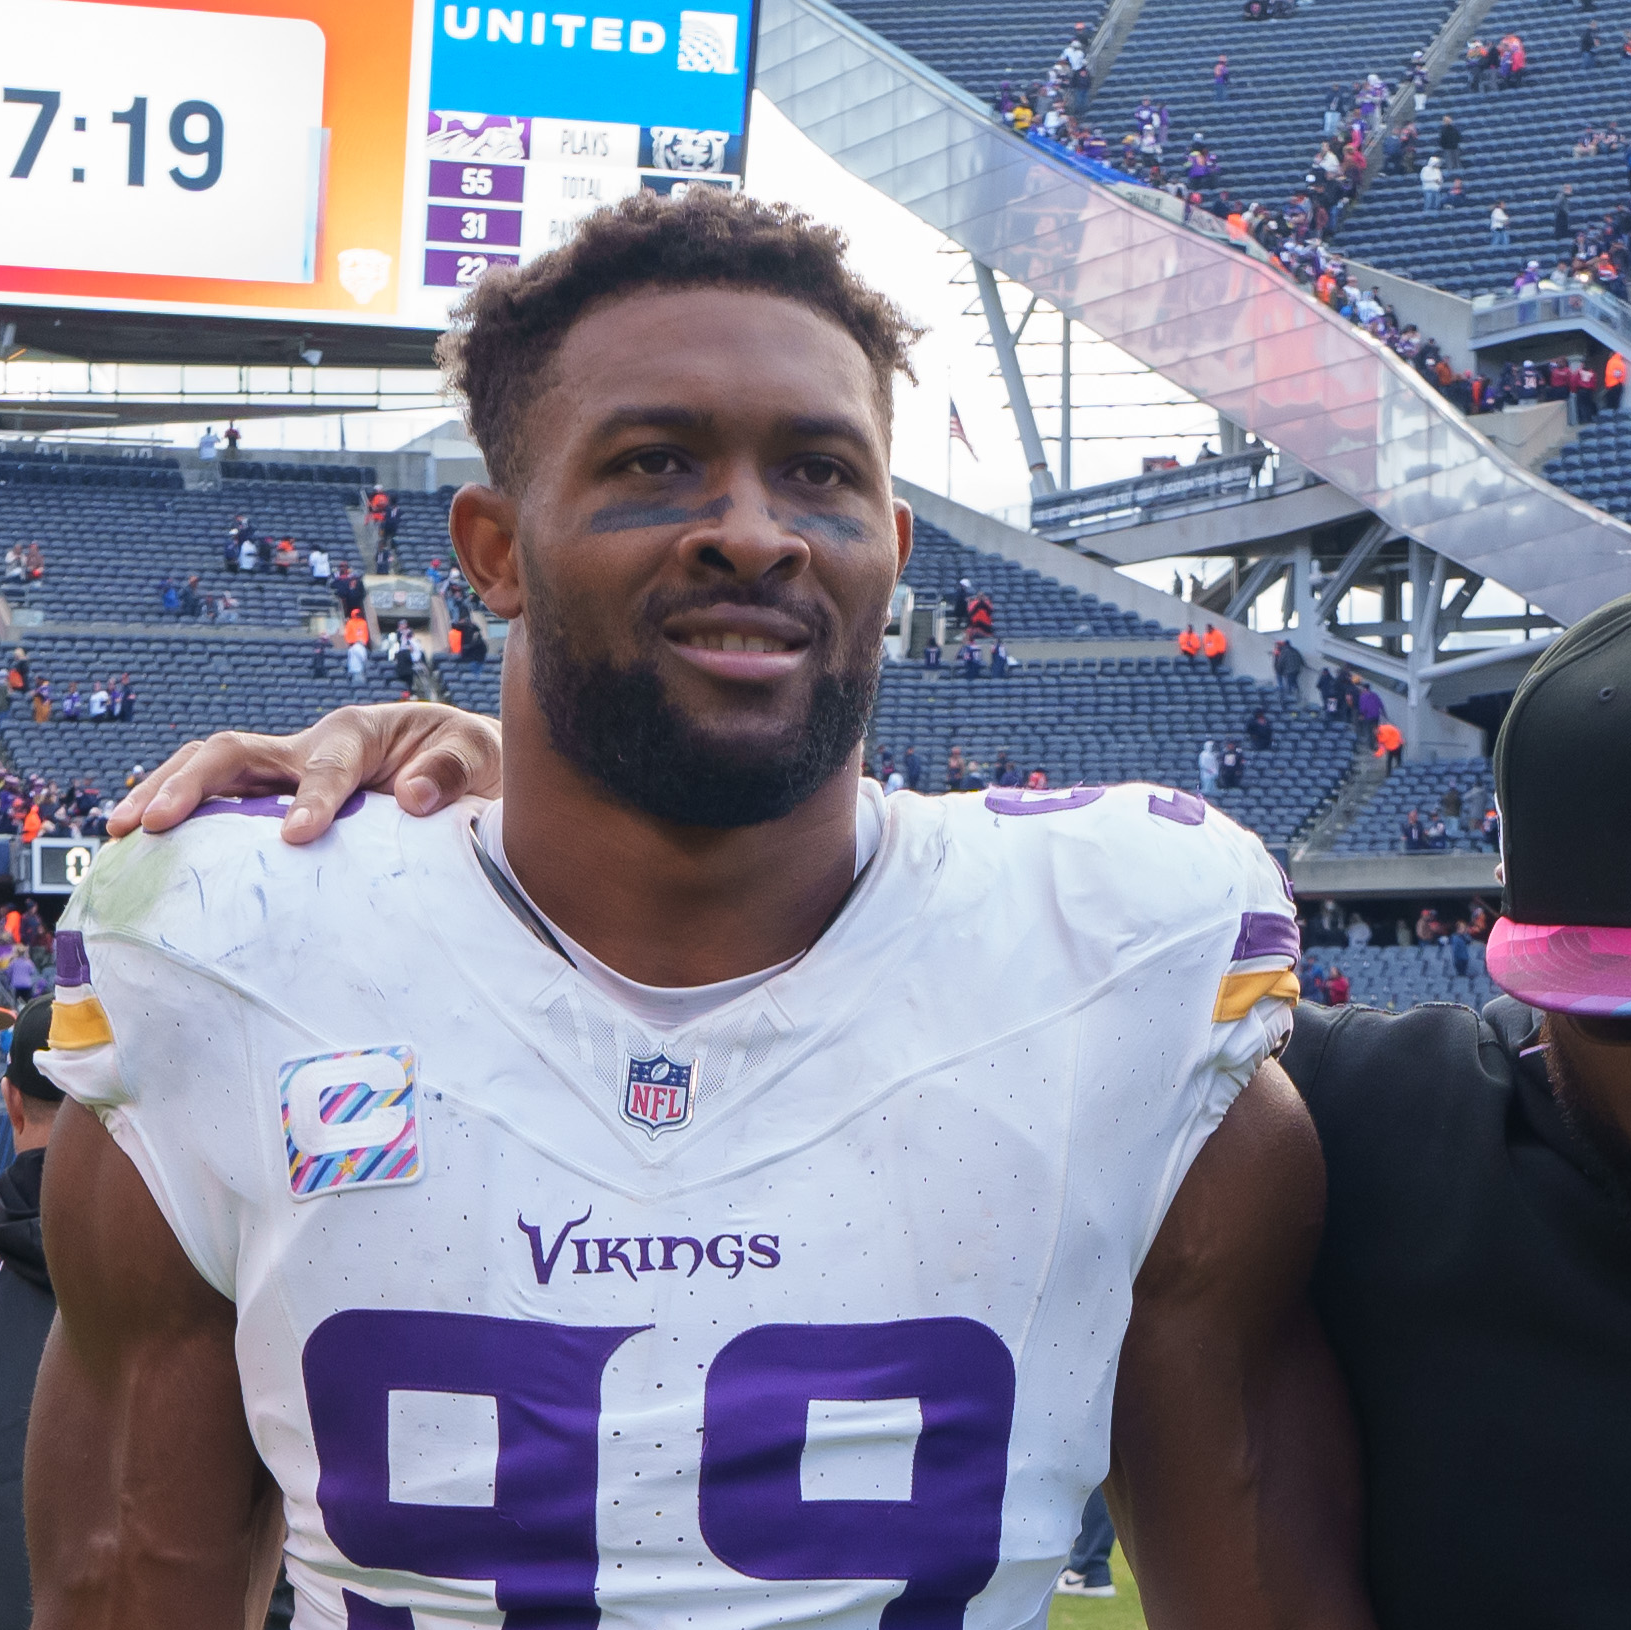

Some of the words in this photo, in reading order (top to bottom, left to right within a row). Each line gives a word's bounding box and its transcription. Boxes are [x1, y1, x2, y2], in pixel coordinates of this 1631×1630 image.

[444, 5, 666, 54] UNITED
[559, 129, 609, 157] PLAYS
[460, 167, 494, 196] 55
[562, 176, 601, 202] TOTAL
[460, 211, 487, 240] 31
[287, 1052, 409, 1156] C
[631, 1084, 682, 1122] NFL
